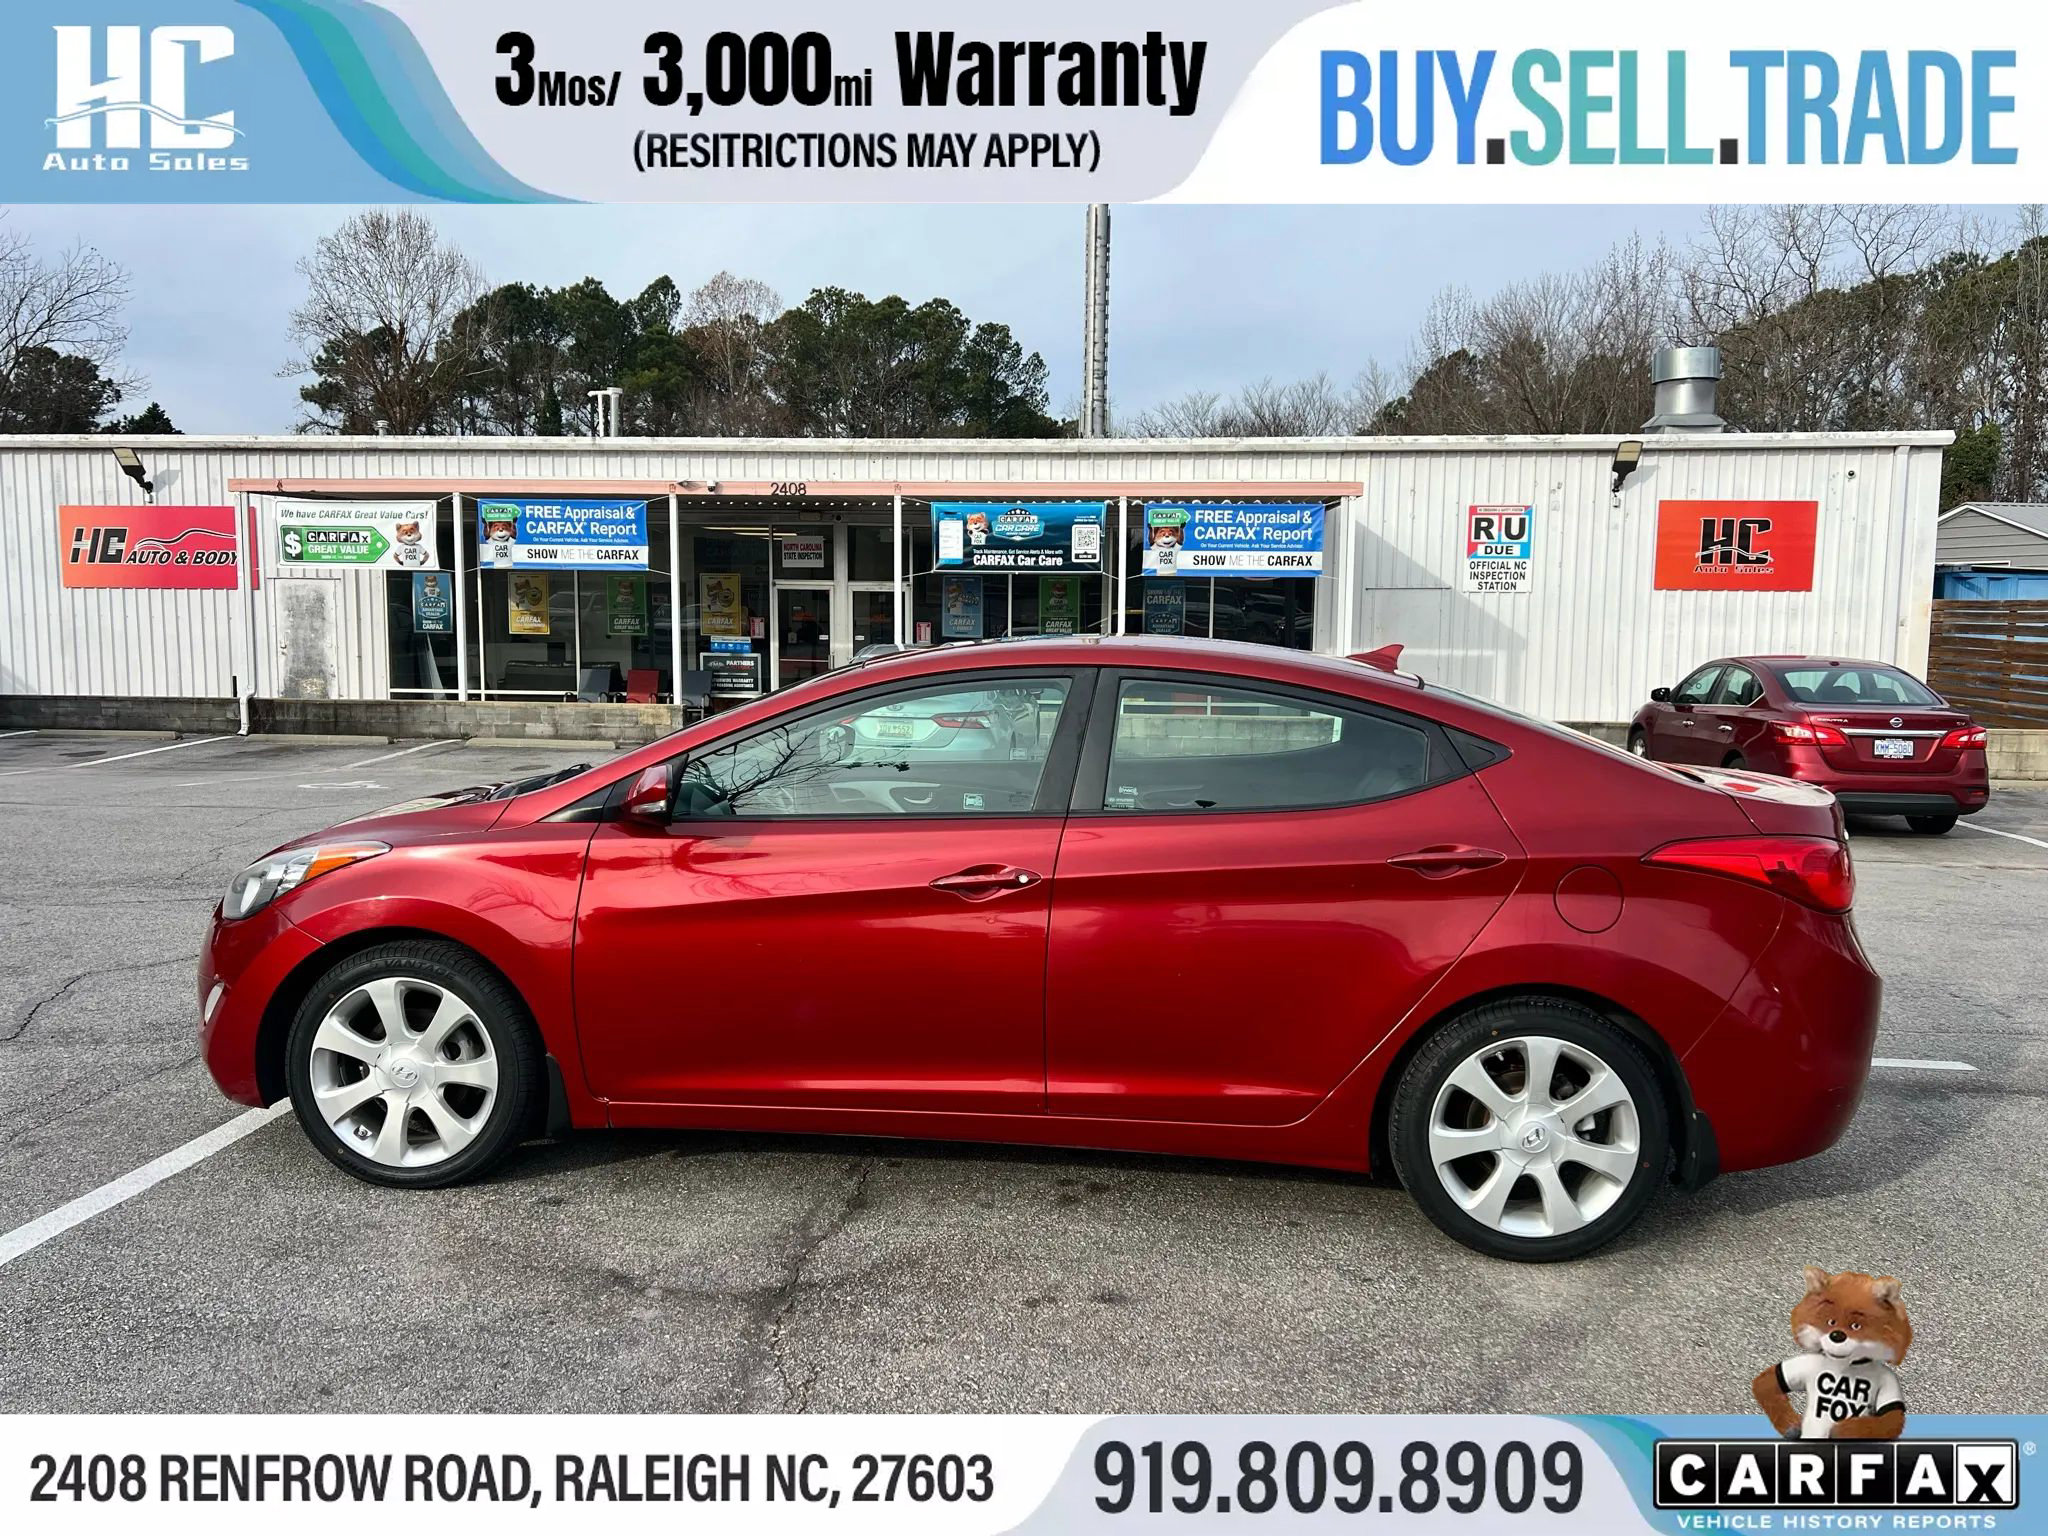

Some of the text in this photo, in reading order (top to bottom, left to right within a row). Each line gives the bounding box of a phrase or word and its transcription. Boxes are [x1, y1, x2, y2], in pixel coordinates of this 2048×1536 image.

[771, 482, 807, 496] 2408
[280, 509, 429, 519] We have CARFAX Great Value Cars!
[525, 506, 635, 522] FREE Appraisal &
[1195, 510, 1313, 526] FREE Appraisal &
[526, 522, 637, 538] CARFAX Report
[1194, 527, 1313, 543] CARFAX Report
[307, 531, 369, 543] CARFAX
[1700, 518, 1772, 565] HC
[70, 527, 128, 564] HC
[308, 545, 370, 554] GREAT VALUE
[784, 543, 822, 551] NORTH CAROLINA
[1484, 546, 1514, 555] DUE
[126, 550, 237, 565] AUTO & BODY
[527, 549, 639, 560] SHOW ME THE CARFAX
[784, 552, 822, 560] STATE INSPECTION
[973, 555, 1063, 566] CARFAX Car Care
[1193, 555, 1313, 567] SHOW ME THE CARFAX
[1469, 561, 1527, 570] OFFICIAL NC
[1469, 571, 1526, 580] INSPECTION
[1734, 566, 1774, 574] Sales
[1477, 582, 1517, 591] STATION
[1147, 596, 1182, 605] CARFAX
